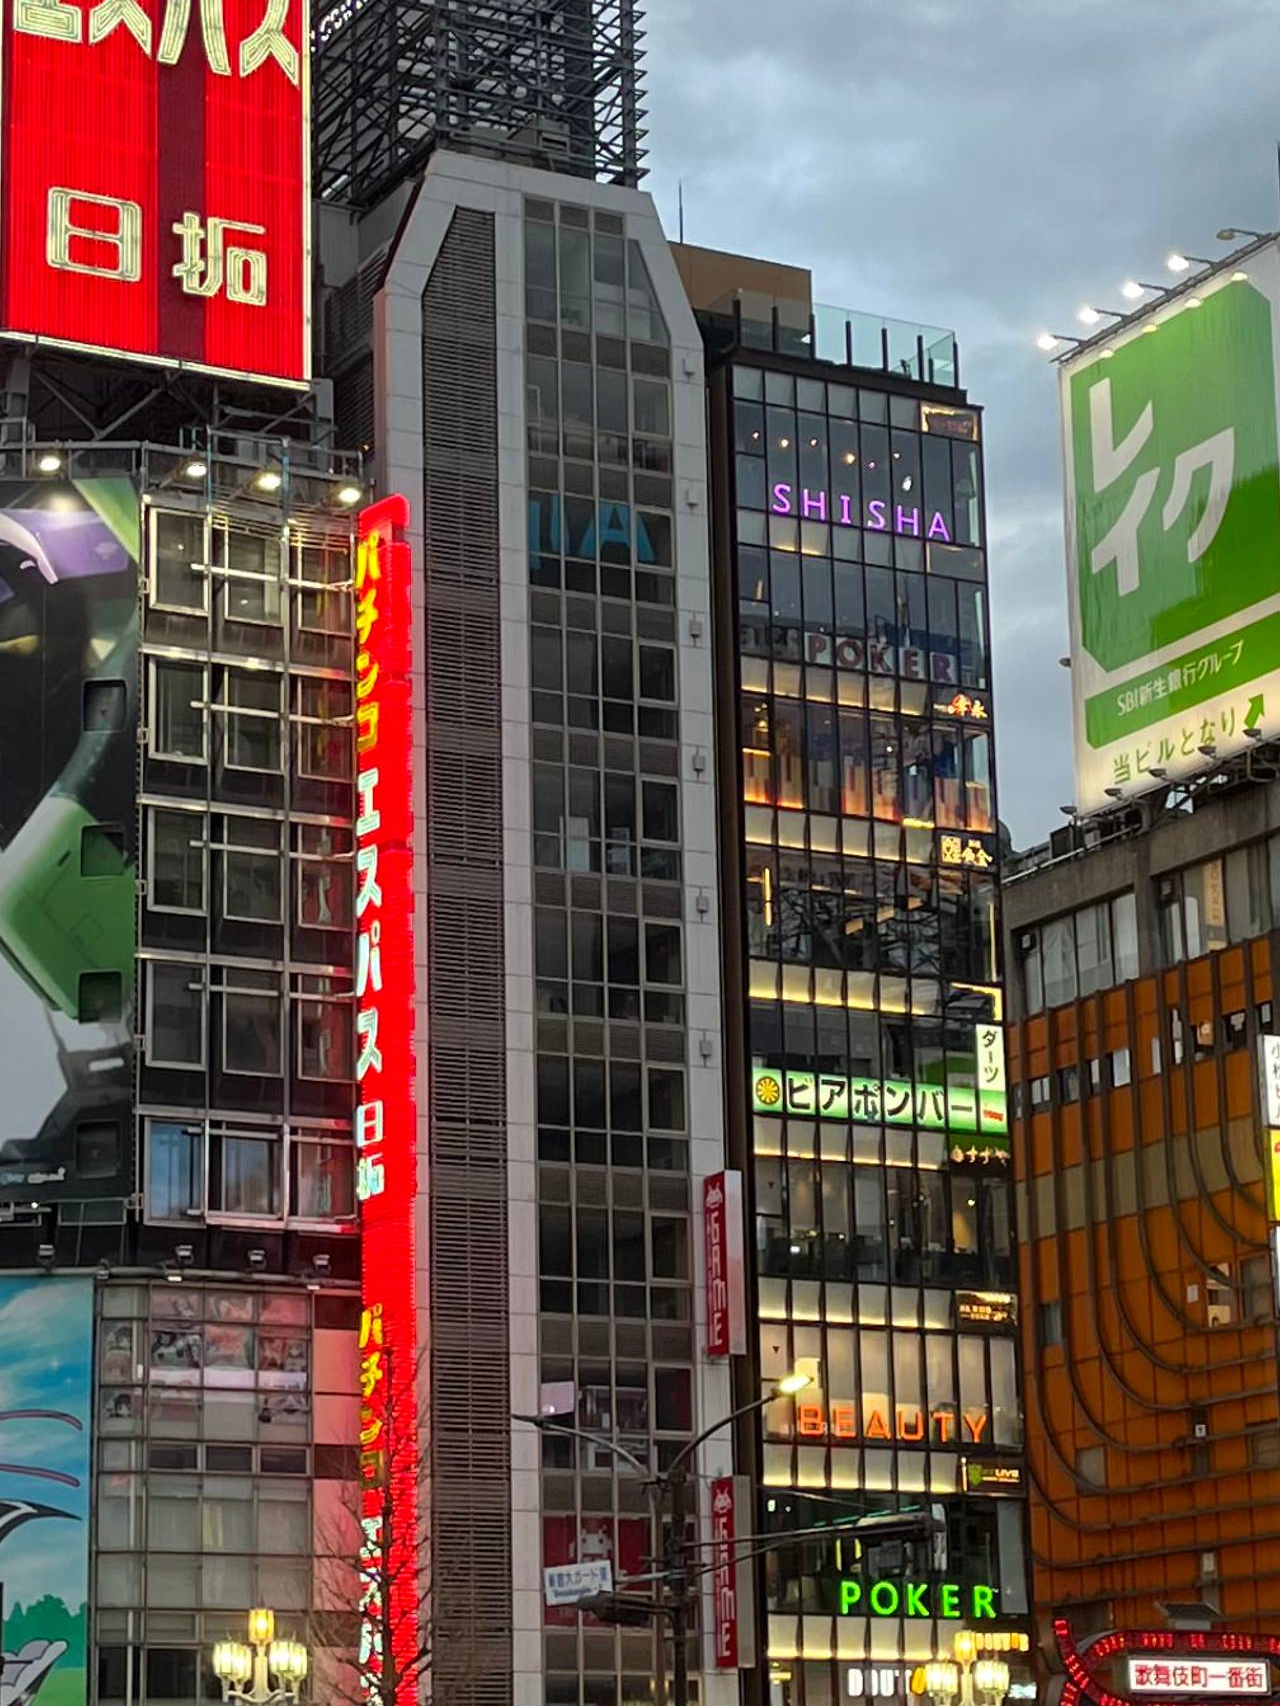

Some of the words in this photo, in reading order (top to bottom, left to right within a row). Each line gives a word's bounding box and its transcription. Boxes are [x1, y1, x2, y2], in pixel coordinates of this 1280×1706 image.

[771, 481, 954, 543] SHISHA
[1088, 378, 1236, 597] レイク
[355, 529, 383, 751] パチンコ
[807, 632, 954, 684] POKER
[1111, 712, 1238, 785] 当ビルとなり
[355, 770, 384, 1084] エスパス
[786, 1076, 974, 1122] ビアポンバー
[797, 1402, 988, 1444] BEAUTY
[839, 1579, 998, 1620] POKER
[1133, 1662, 1265, 1690] 歌舞伎町一番街
